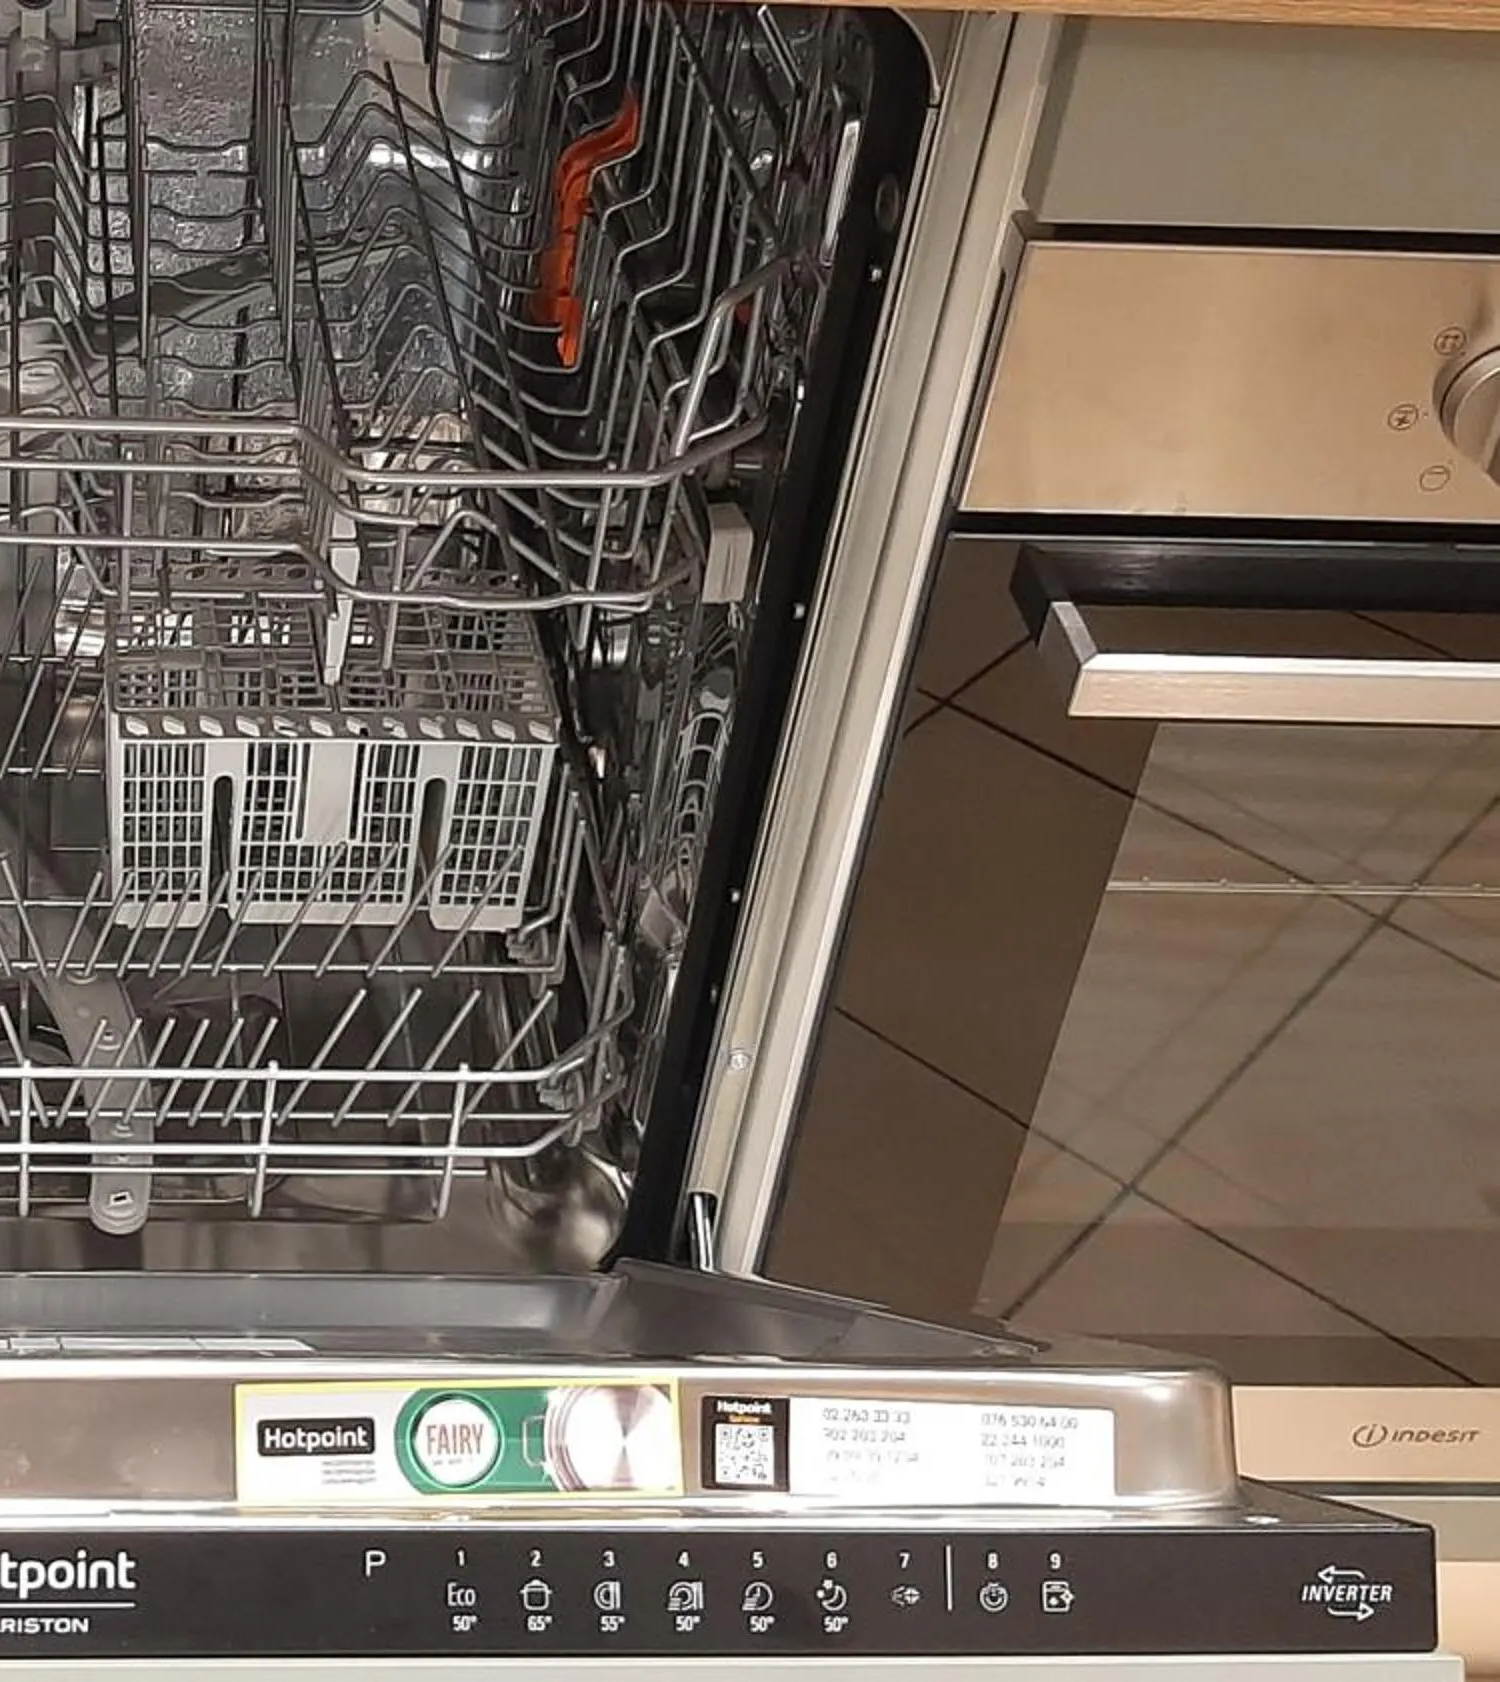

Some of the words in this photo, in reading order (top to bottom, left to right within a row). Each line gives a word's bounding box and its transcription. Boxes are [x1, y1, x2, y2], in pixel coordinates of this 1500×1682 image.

[716, 1400, 772, 1414] Hotpoint
[263, 1424, 369, 1453] Hotpoint
[426, 1423, 484, 1456] FAIRY
[365, 1550, 386, 1577] P
[457, 1550, 465, 1566] 1
[531, 1550, 541, 1567] 2
[603, 1550, 615, 1567] 3
[677, 1551, 689, 1567] 4
[752, 1551, 763, 1569] 5
[826, 1551, 837, 1569] 6
[899, 1552, 910, 1569] 7
[987, 1552, 999, 1570] 8
[1050, 1553, 1061, 1570] 9
[447, 1582, 476, 1607] Eco
[1301, 1584, 1393, 1602] INVERTER
[453, 1615, 477, 1632] 50°
[600, 1615, 625, 1632] 55°
[675, 1615, 701, 1632] 50°
[750, 1615, 775, 1633] 50°
[824, 1615, 849, 1633] 50°
